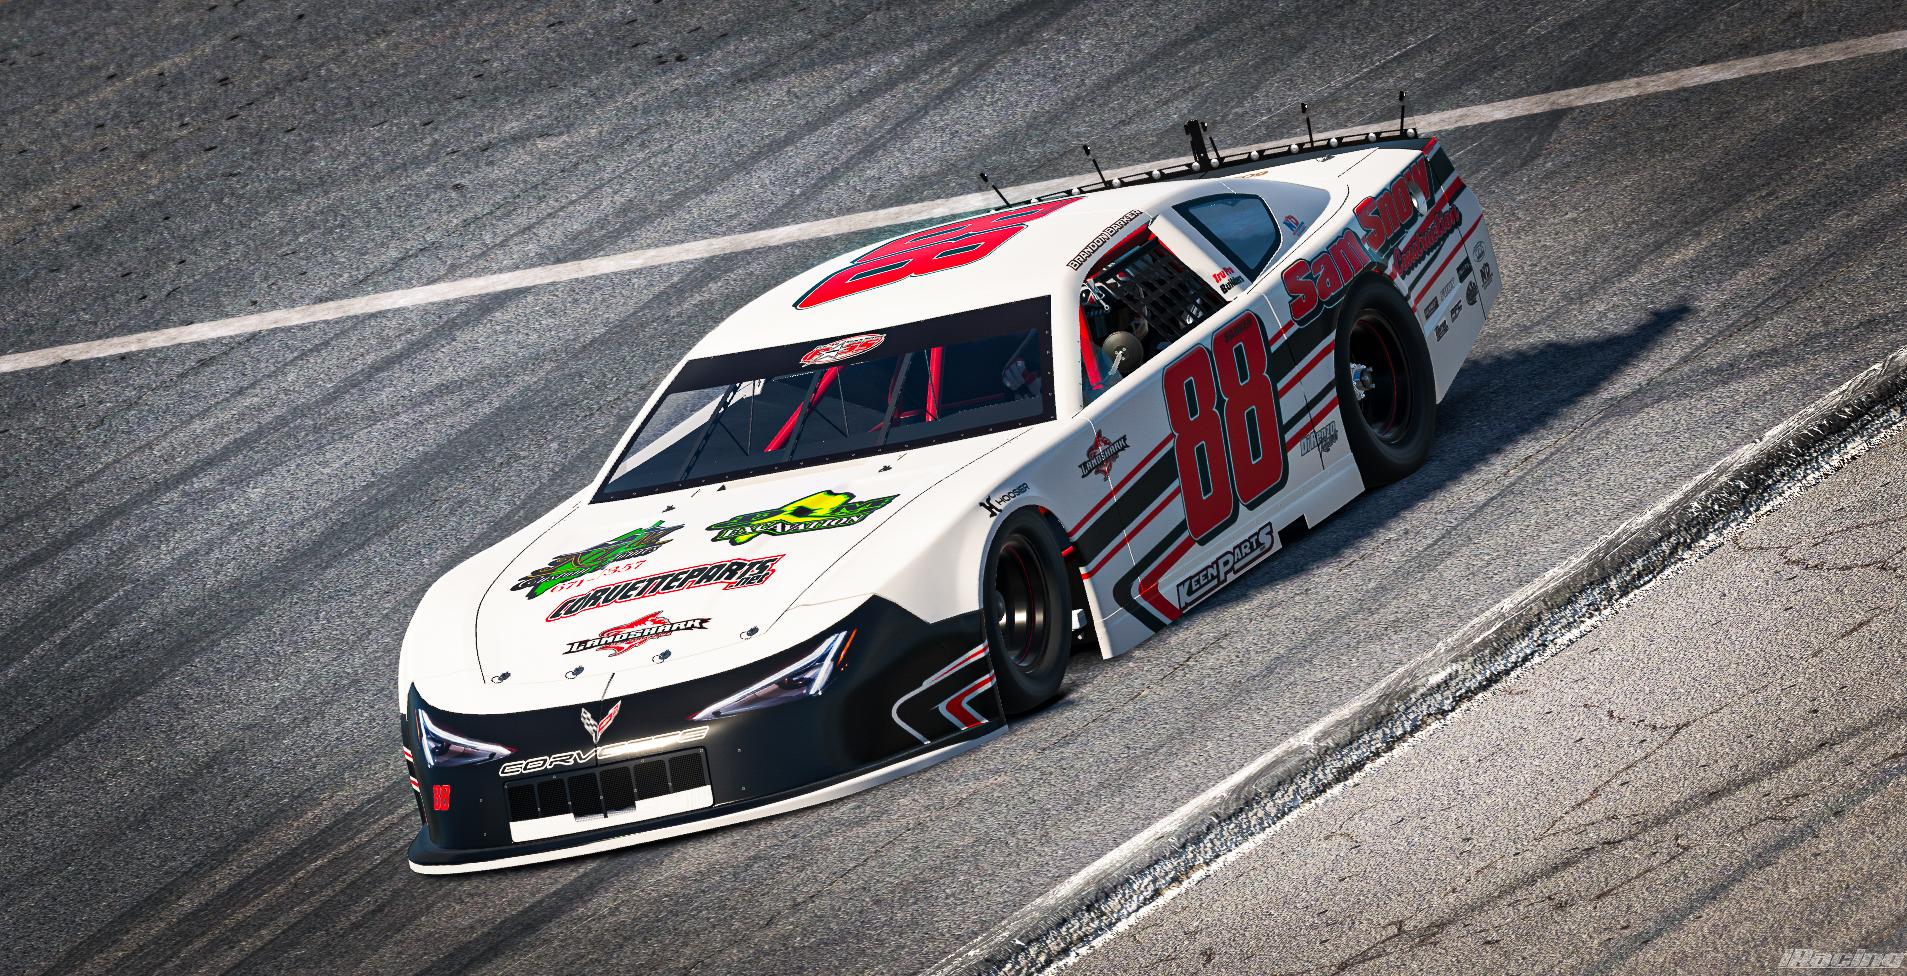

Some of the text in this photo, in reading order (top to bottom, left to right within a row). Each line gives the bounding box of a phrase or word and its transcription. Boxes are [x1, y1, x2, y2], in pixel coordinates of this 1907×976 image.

[793, 196, 1087, 310] 88
[1068, 209, 1144, 271] BRANDON BARKER
[1281, 228, 1372, 323] Sam
[1079, 436, 1129, 477] LANDSHARK
[1162, 310, 1288, 546] 88
[994, 482, 1031, 506] HOOSIER
[547, 556, 779, 621] CORVETTEPARTS
[567, 617, 705, 653] LANDSHARK
[432, 784, 451, 811] 88
